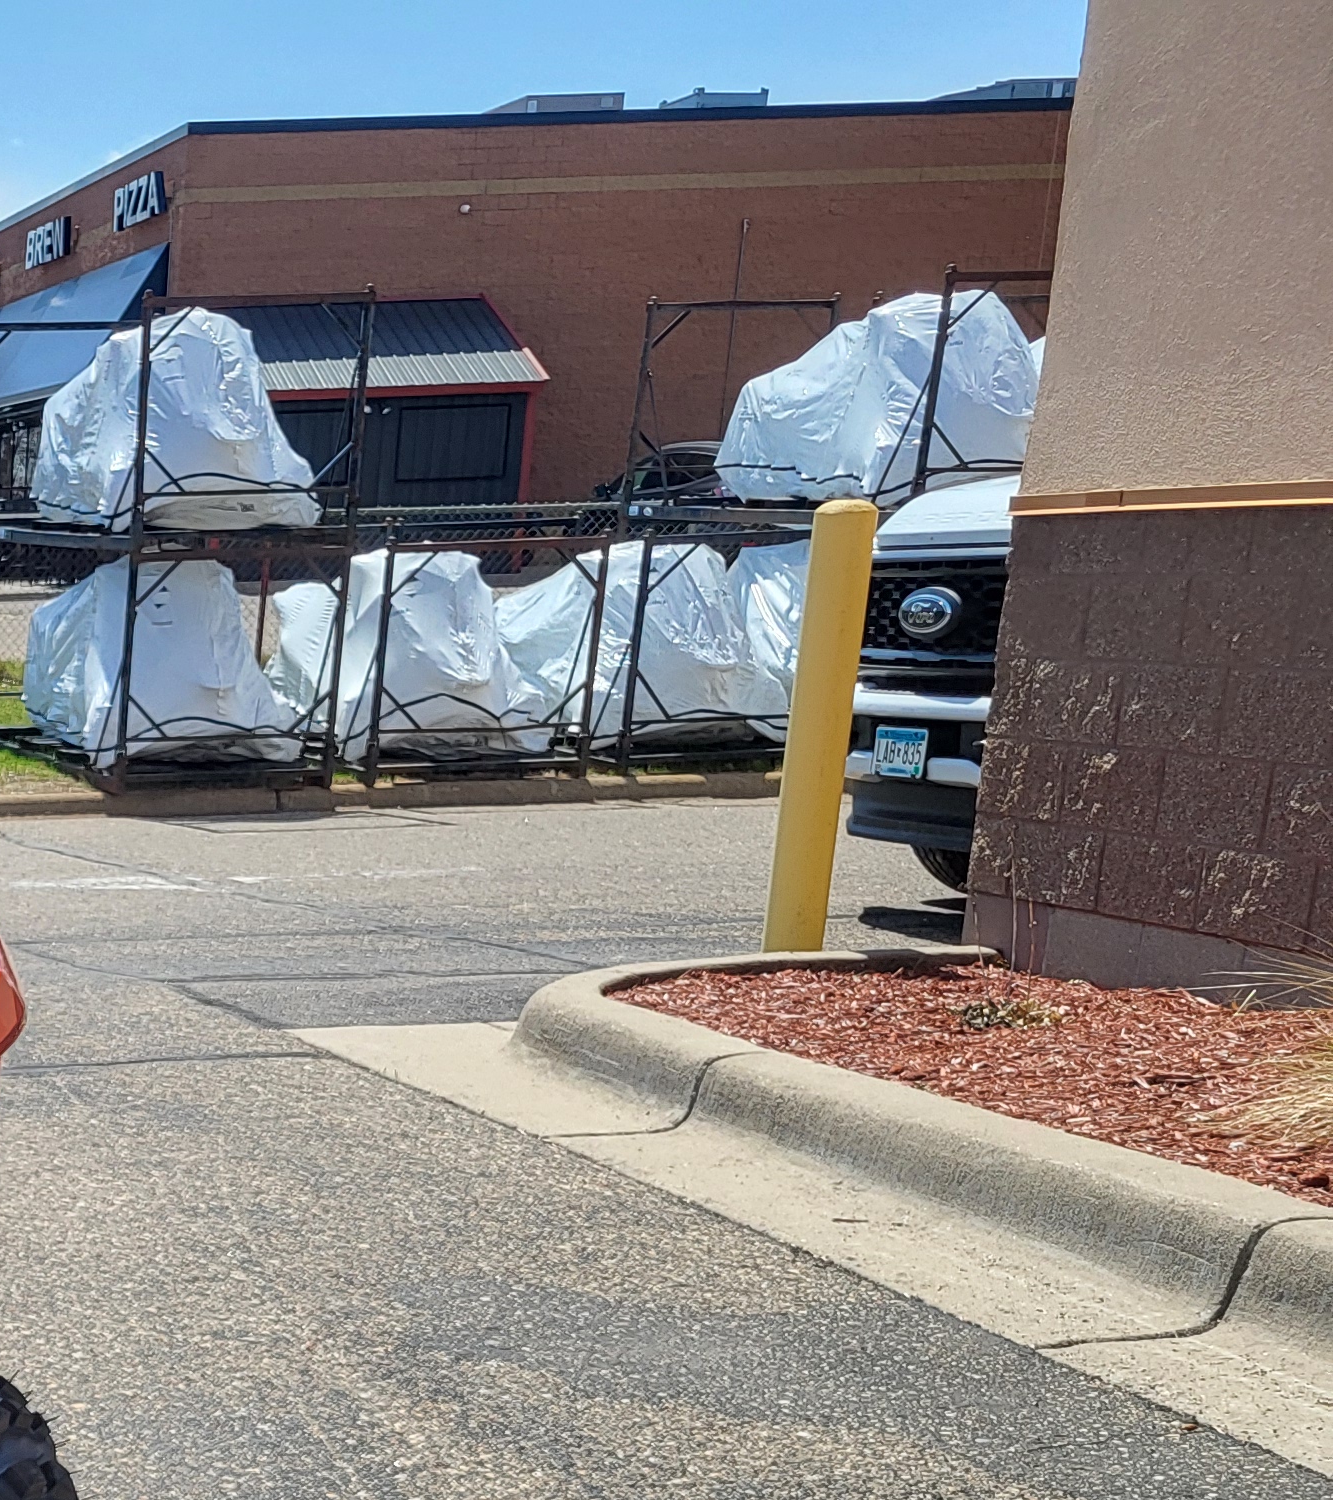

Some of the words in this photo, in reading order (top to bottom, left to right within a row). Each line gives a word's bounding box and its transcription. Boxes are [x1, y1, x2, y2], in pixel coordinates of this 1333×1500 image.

[25, 216, 69, 270] BREW
[112, 171, 166, 232] PIZZA
[907, 601, 938, 624] Ford
[875, 740, 897, 764] LAB
[901, 741, 923, 766] 835
